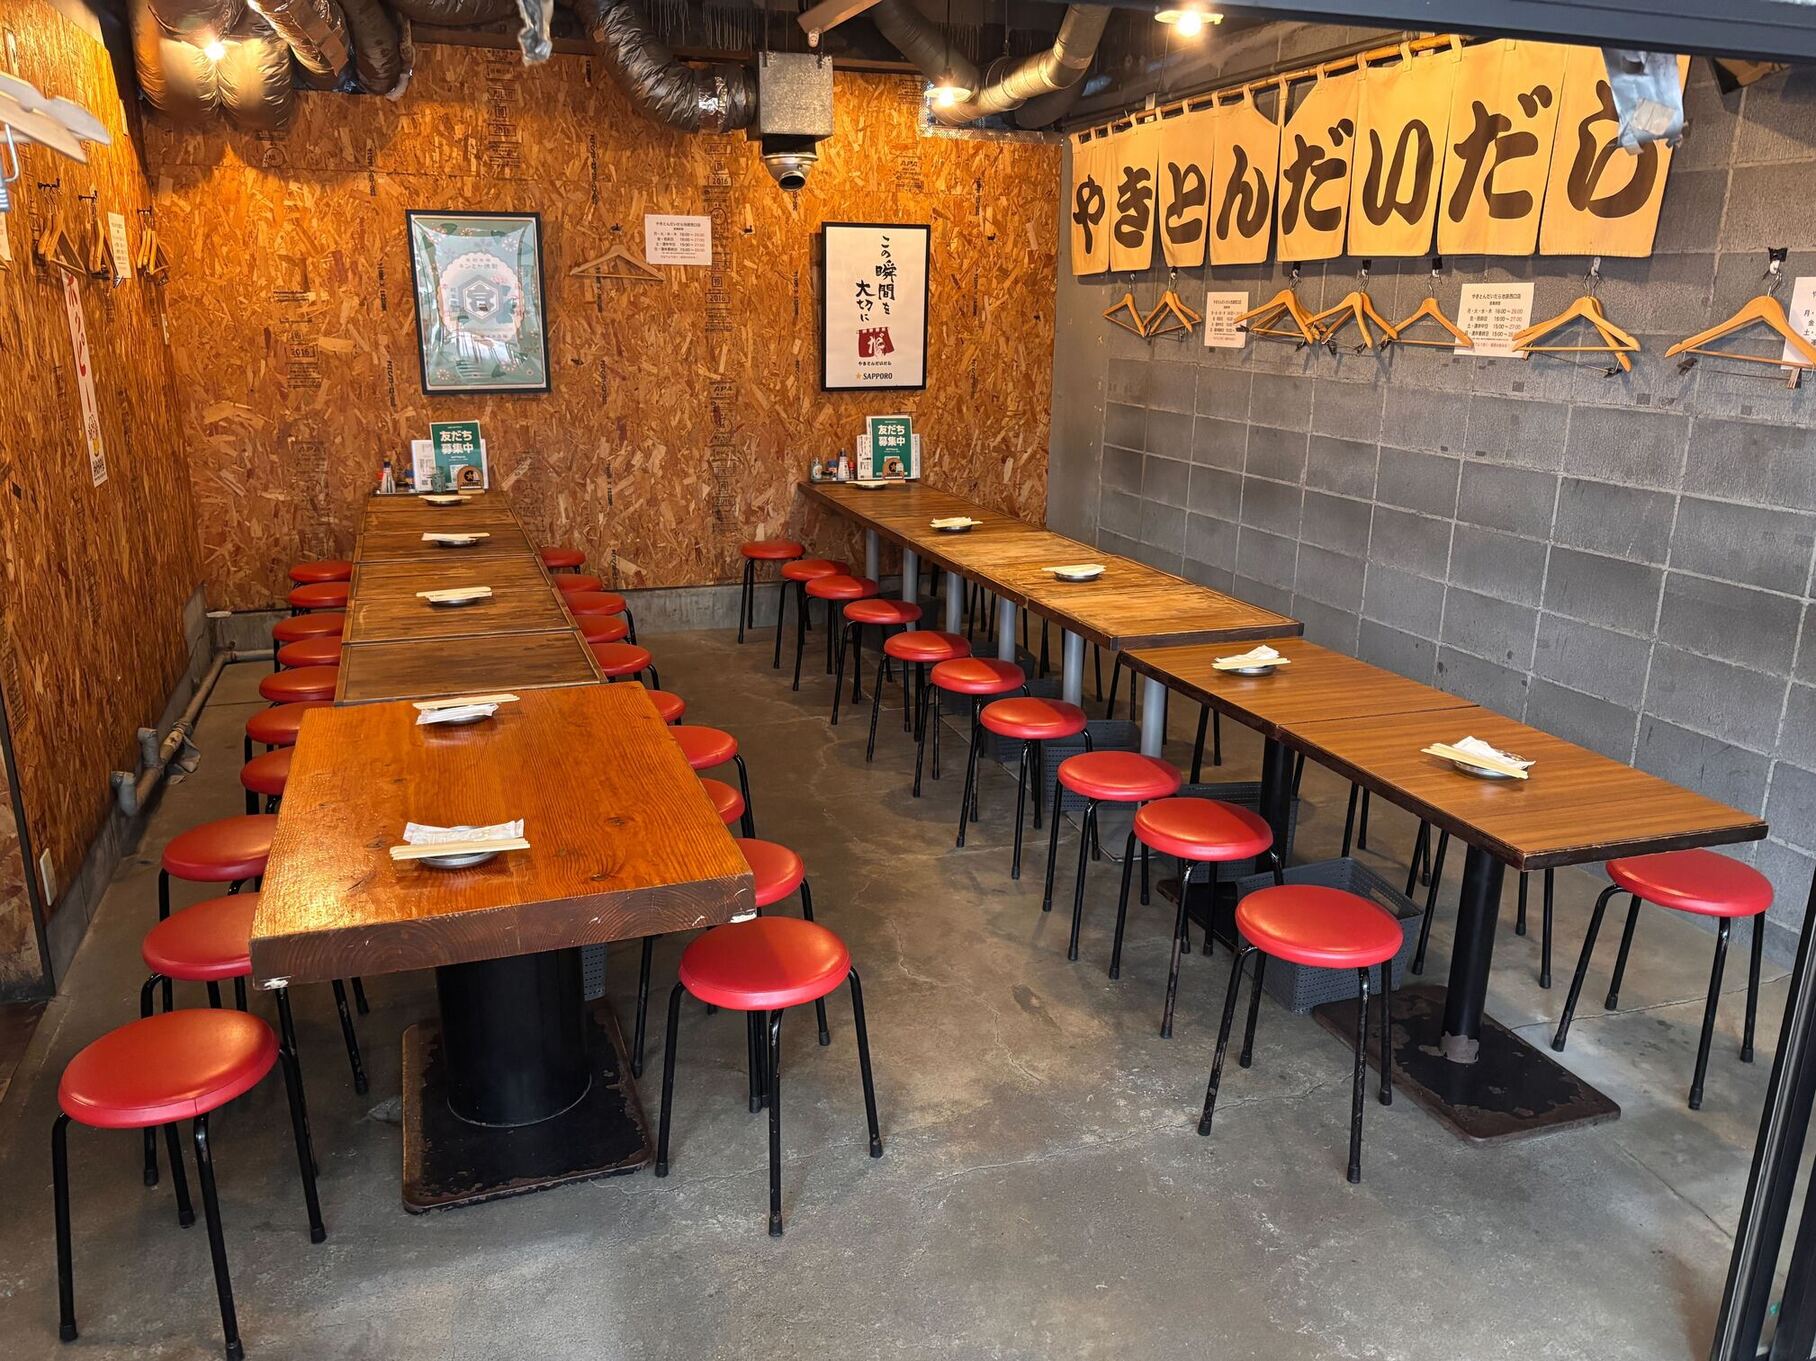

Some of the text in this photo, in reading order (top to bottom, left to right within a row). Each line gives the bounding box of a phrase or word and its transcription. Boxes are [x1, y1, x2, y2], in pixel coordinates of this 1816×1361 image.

[875, 235, 897, 315] この瞬間を
[855, 279, 875, 322] 大切に
[714, 385, 733, 393] APA
[877, 424, 905, 435] 友だち
[440, 430, 473, 442] 友だち
[878, 436, 906, 446] 募集中
[441, 443, 474, 455] 募集中
